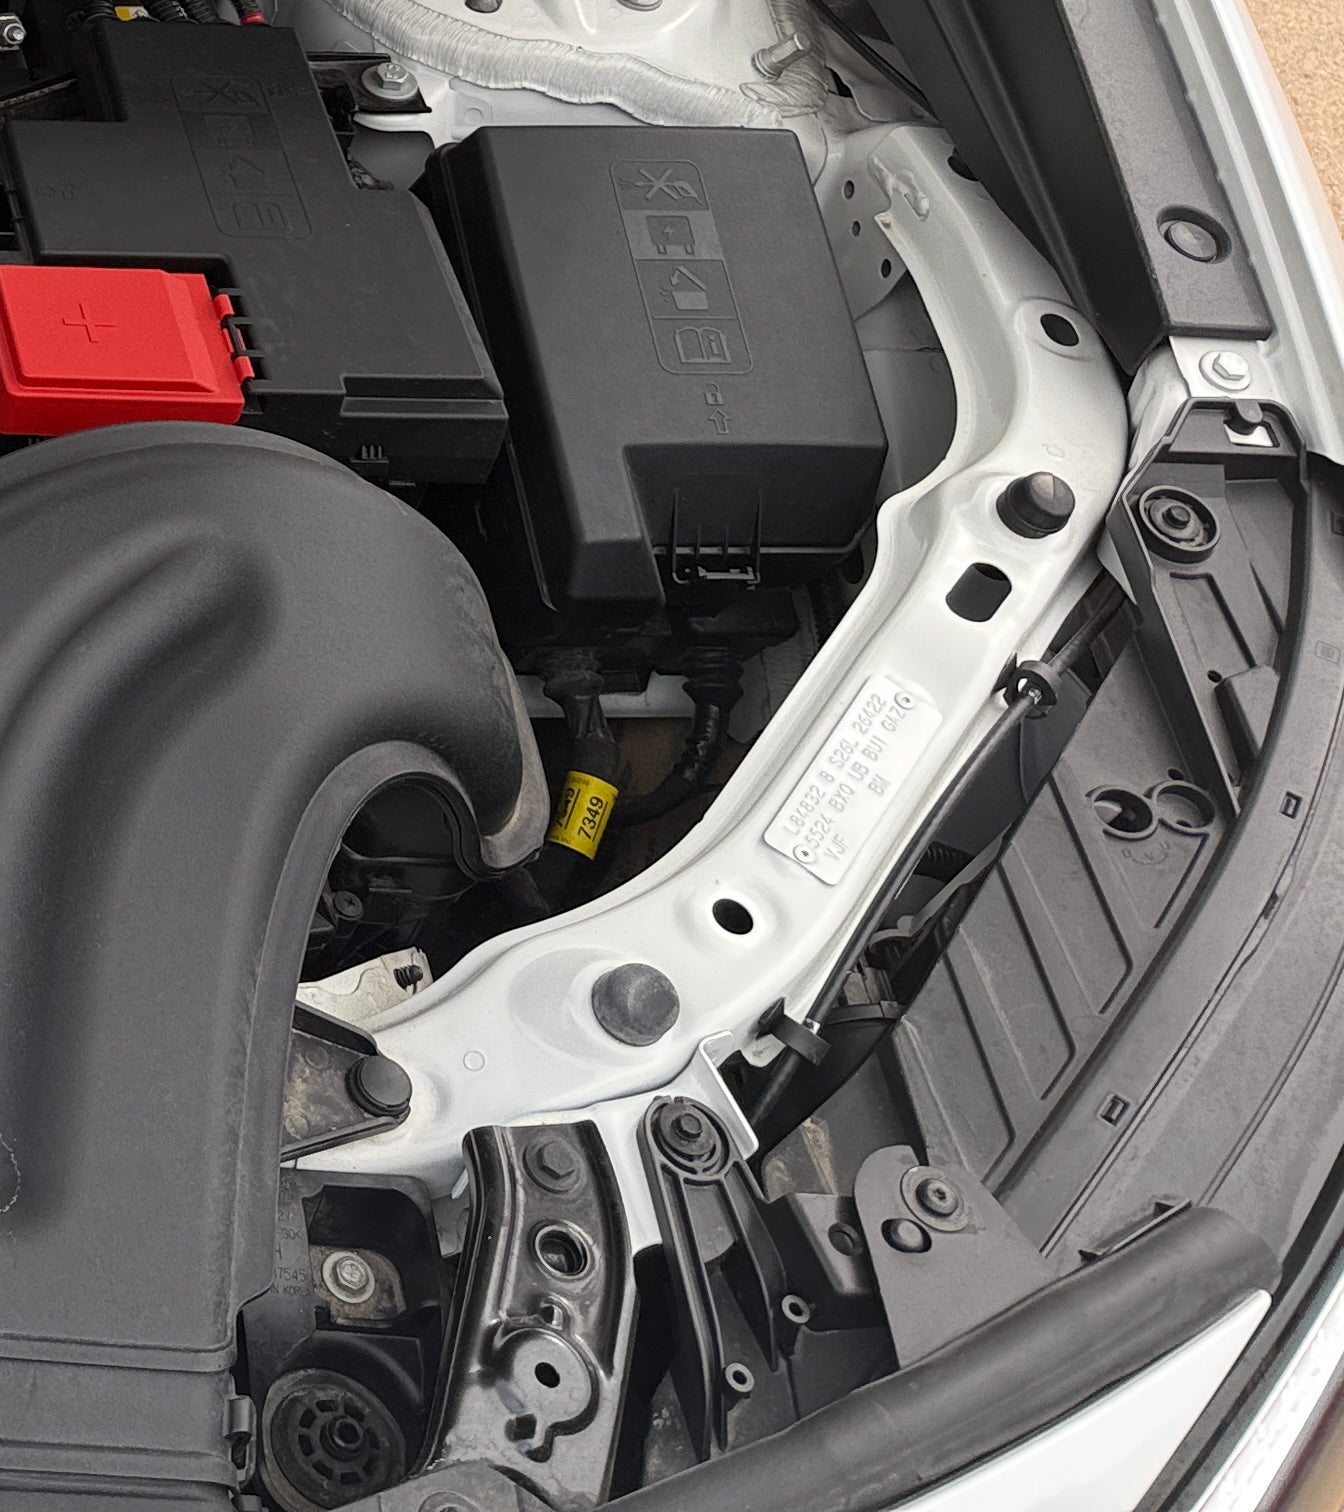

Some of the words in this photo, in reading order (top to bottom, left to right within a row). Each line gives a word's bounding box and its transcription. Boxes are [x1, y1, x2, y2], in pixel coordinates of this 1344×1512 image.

[577, 795, 604, 840] 7349
[784, 784, 826, 836] L84832
[819, 769, 835, 783] 8
[805, 813, 833, 850] 5524
[823, 835, 848, 862] VJF
